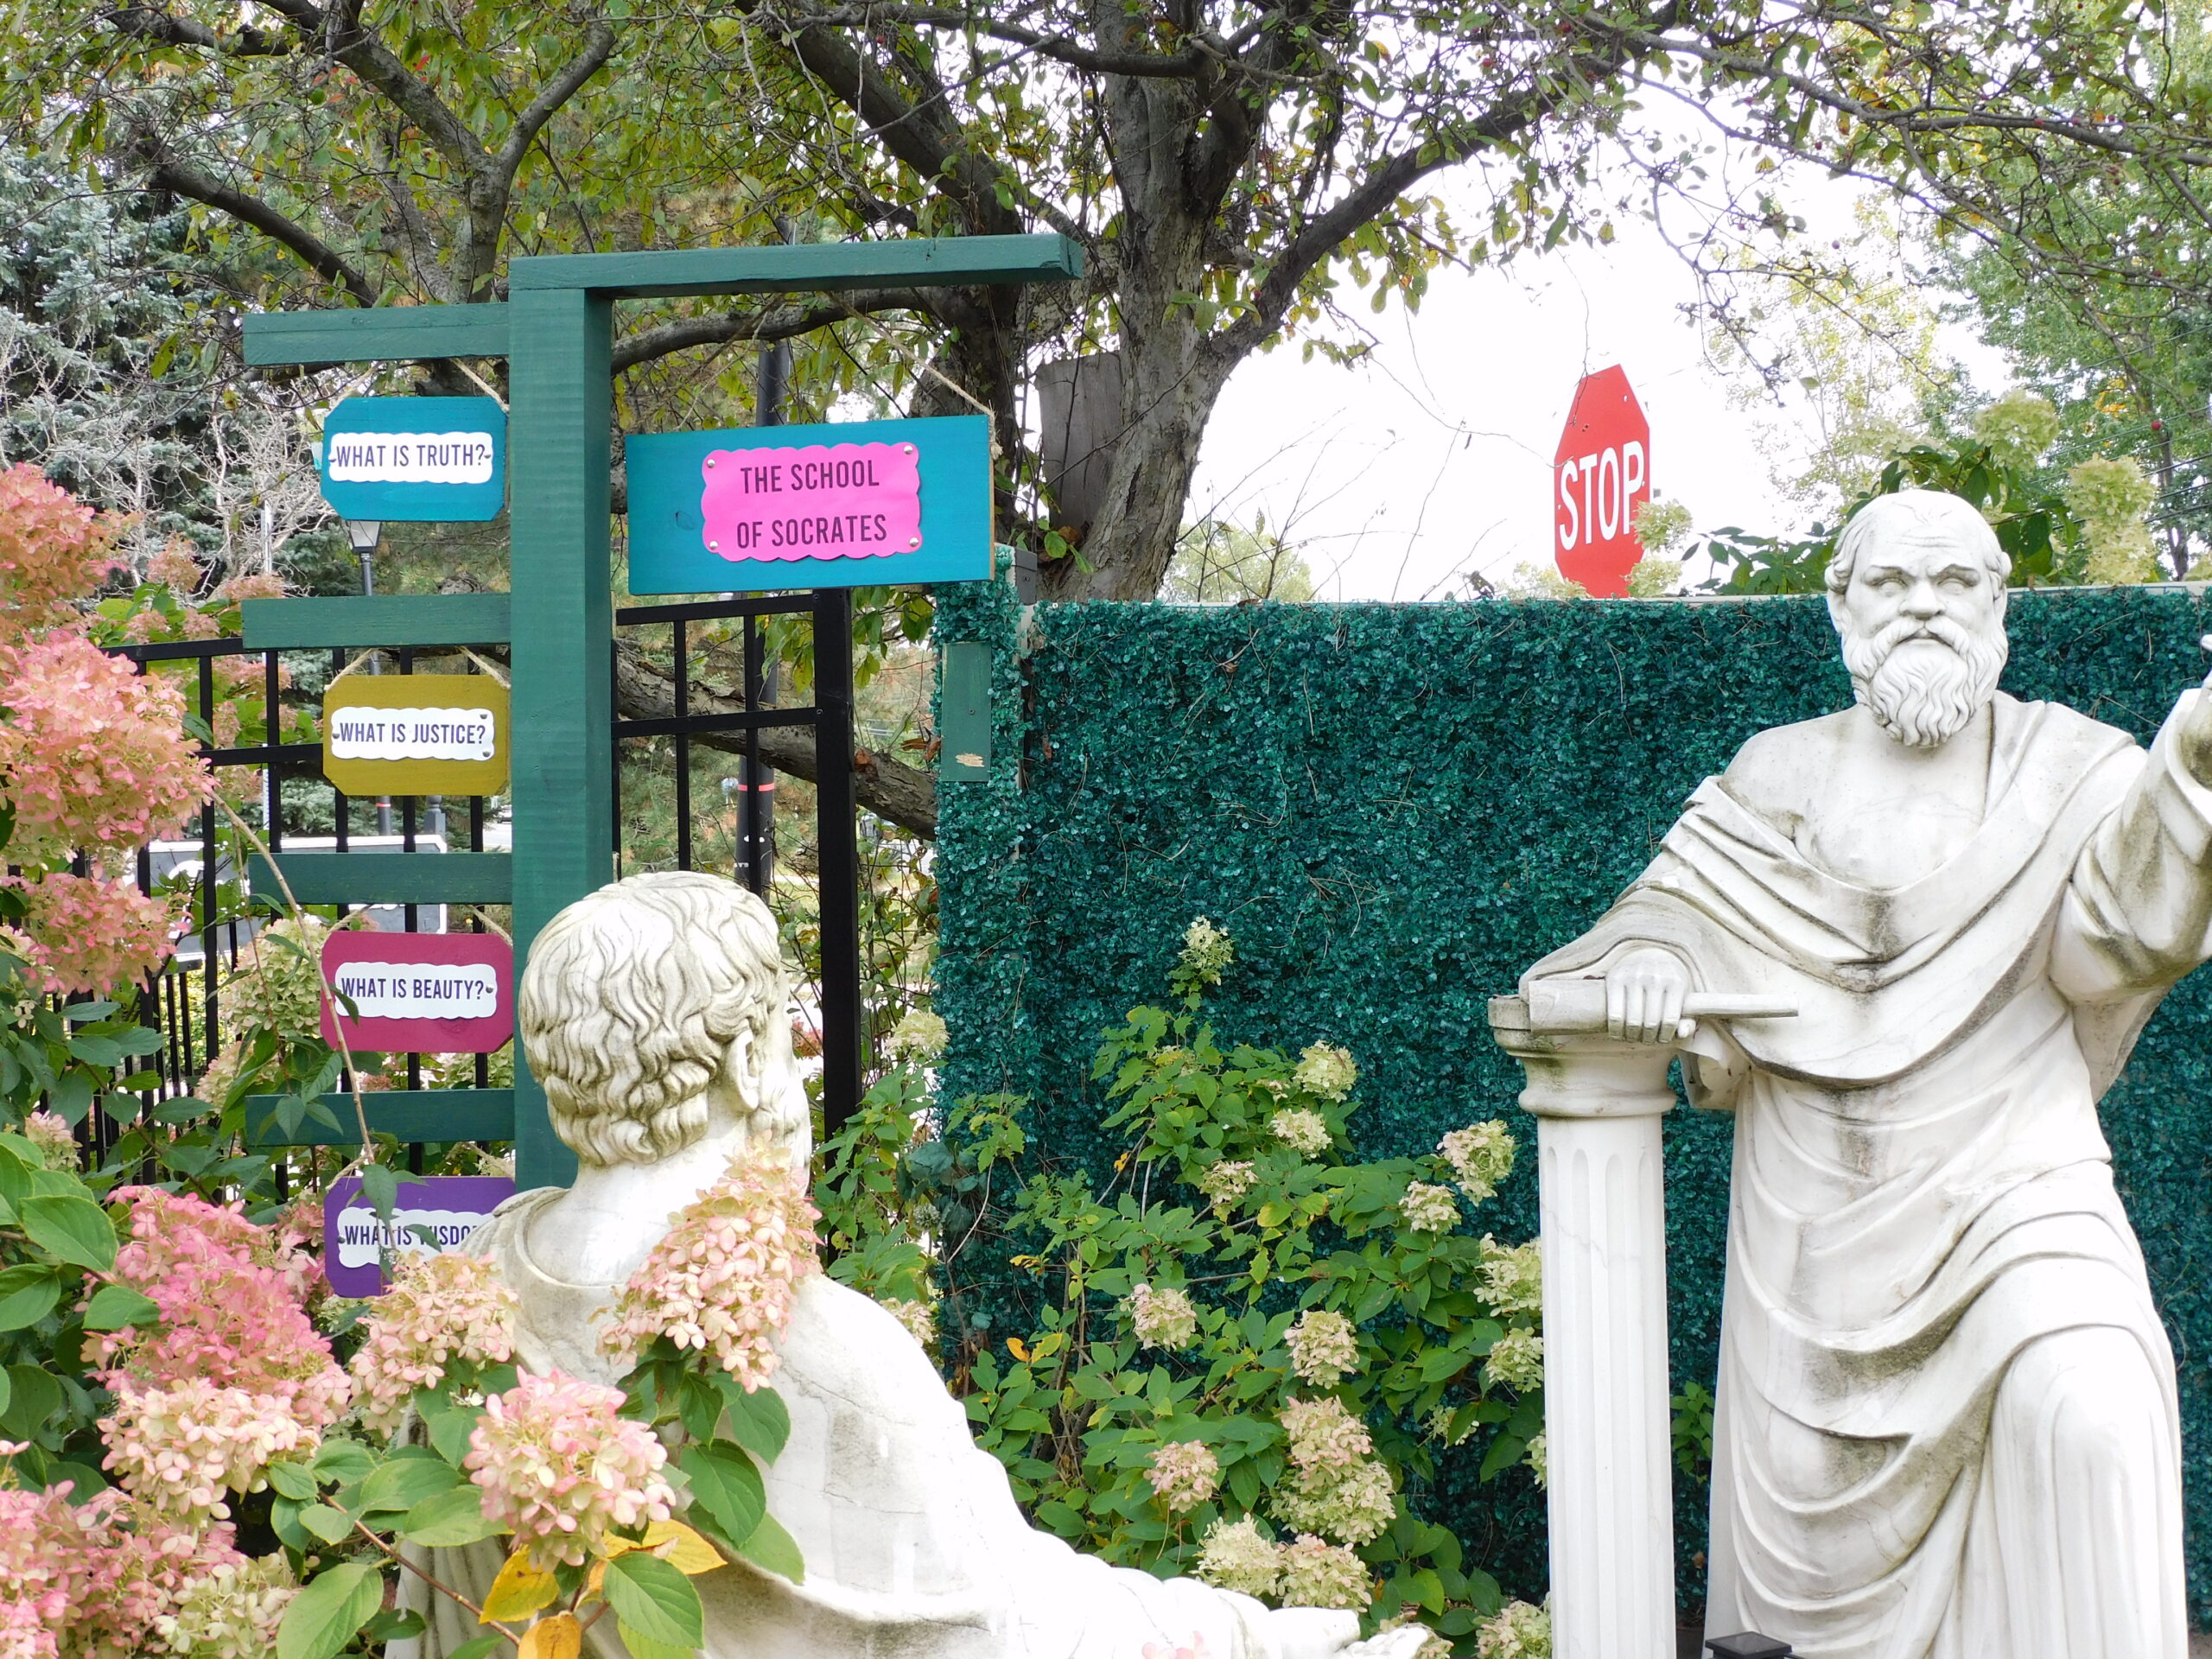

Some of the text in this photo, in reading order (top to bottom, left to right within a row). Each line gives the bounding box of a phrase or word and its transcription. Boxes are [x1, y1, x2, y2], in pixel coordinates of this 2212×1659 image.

[336, 443, 486, 467] WHAT IS TRUTH?
[741, 459, 880, 493] THE SCHOOL
[1560, 440, 1644, 550] STOP
[737, 513, 887, 549] OF SOCRATES
[340, 722, 486, 744] WHAT IS JUSTICE?
[340, 977, 485, 1000] WHAT IS BEAUTY?
[344, 1225, 389, 1245] WHAT
[397, 1225, 412, 1245] IS
